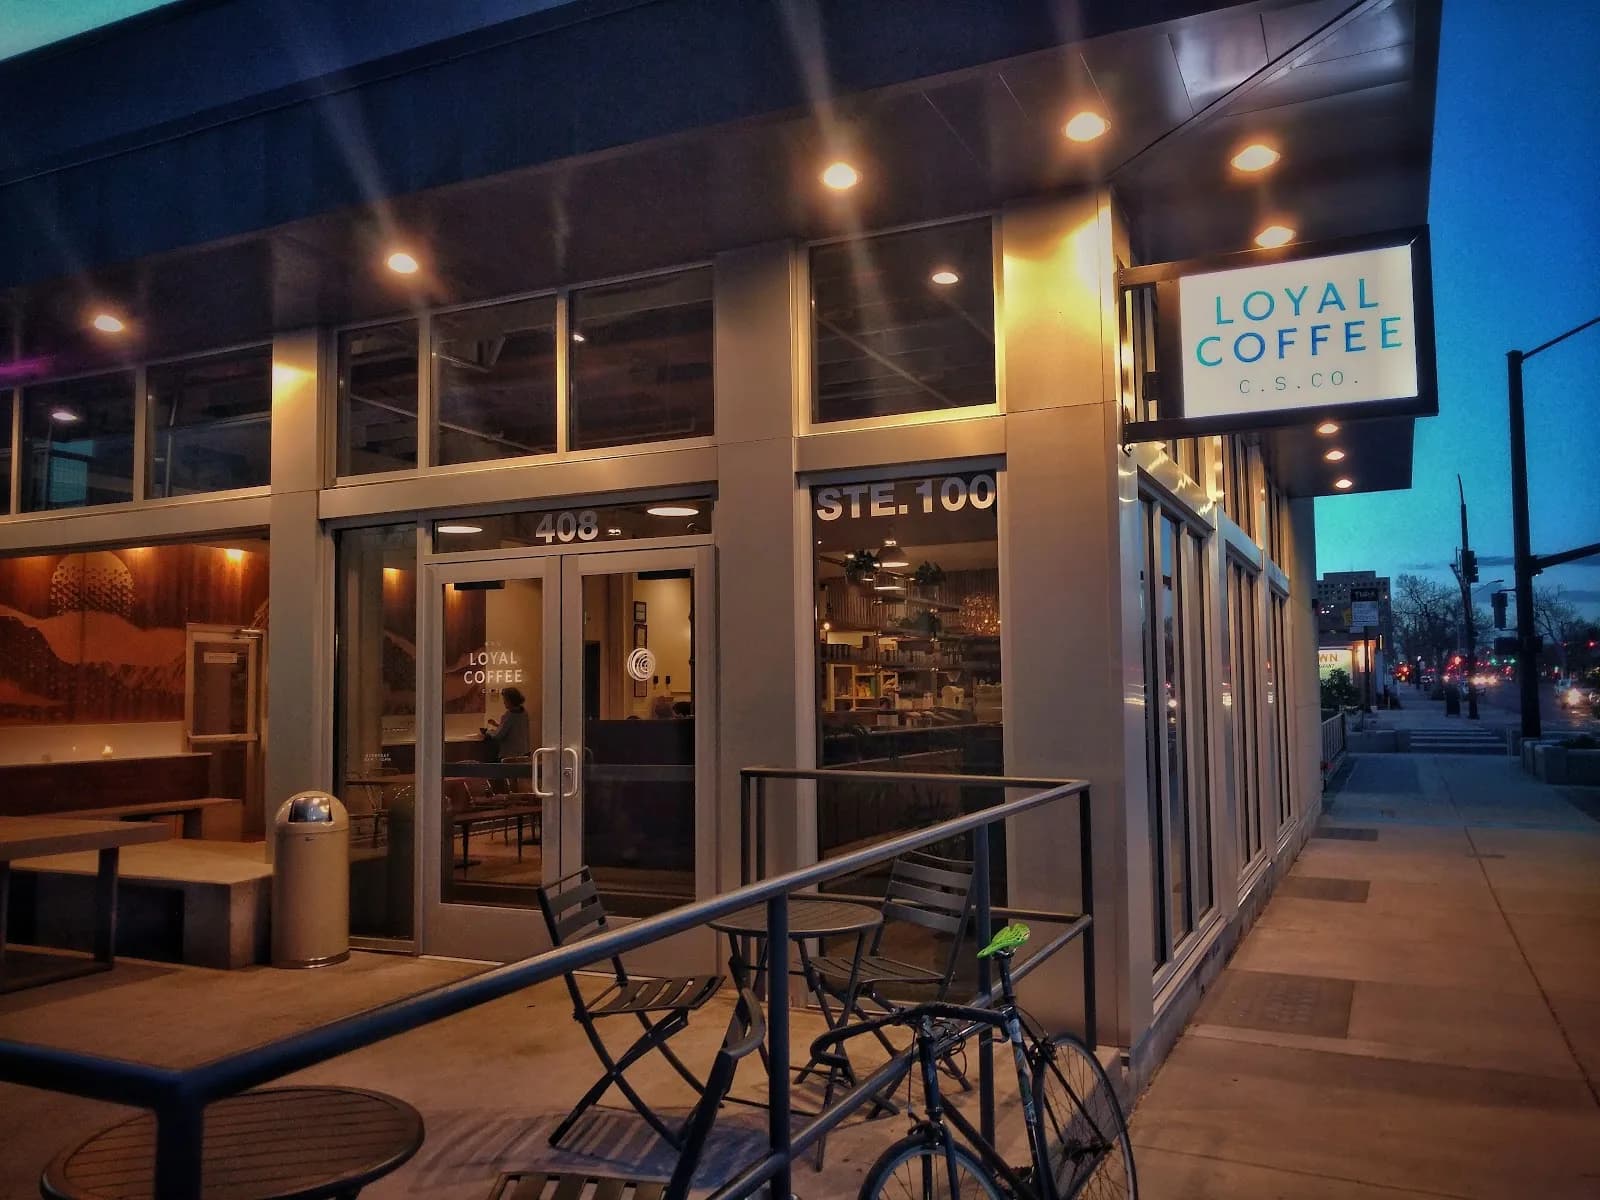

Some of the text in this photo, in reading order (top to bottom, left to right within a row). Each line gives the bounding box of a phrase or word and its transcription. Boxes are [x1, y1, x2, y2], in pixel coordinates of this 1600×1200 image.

[1215, 278, 1379, 325] LOYAL
[1196, 317, 1402, 367] COFFEE
[535, 510, 599, 543] 408
[469, 651, 518, 666] LOYAL
[463, 669, 523, 685] COFFEE
